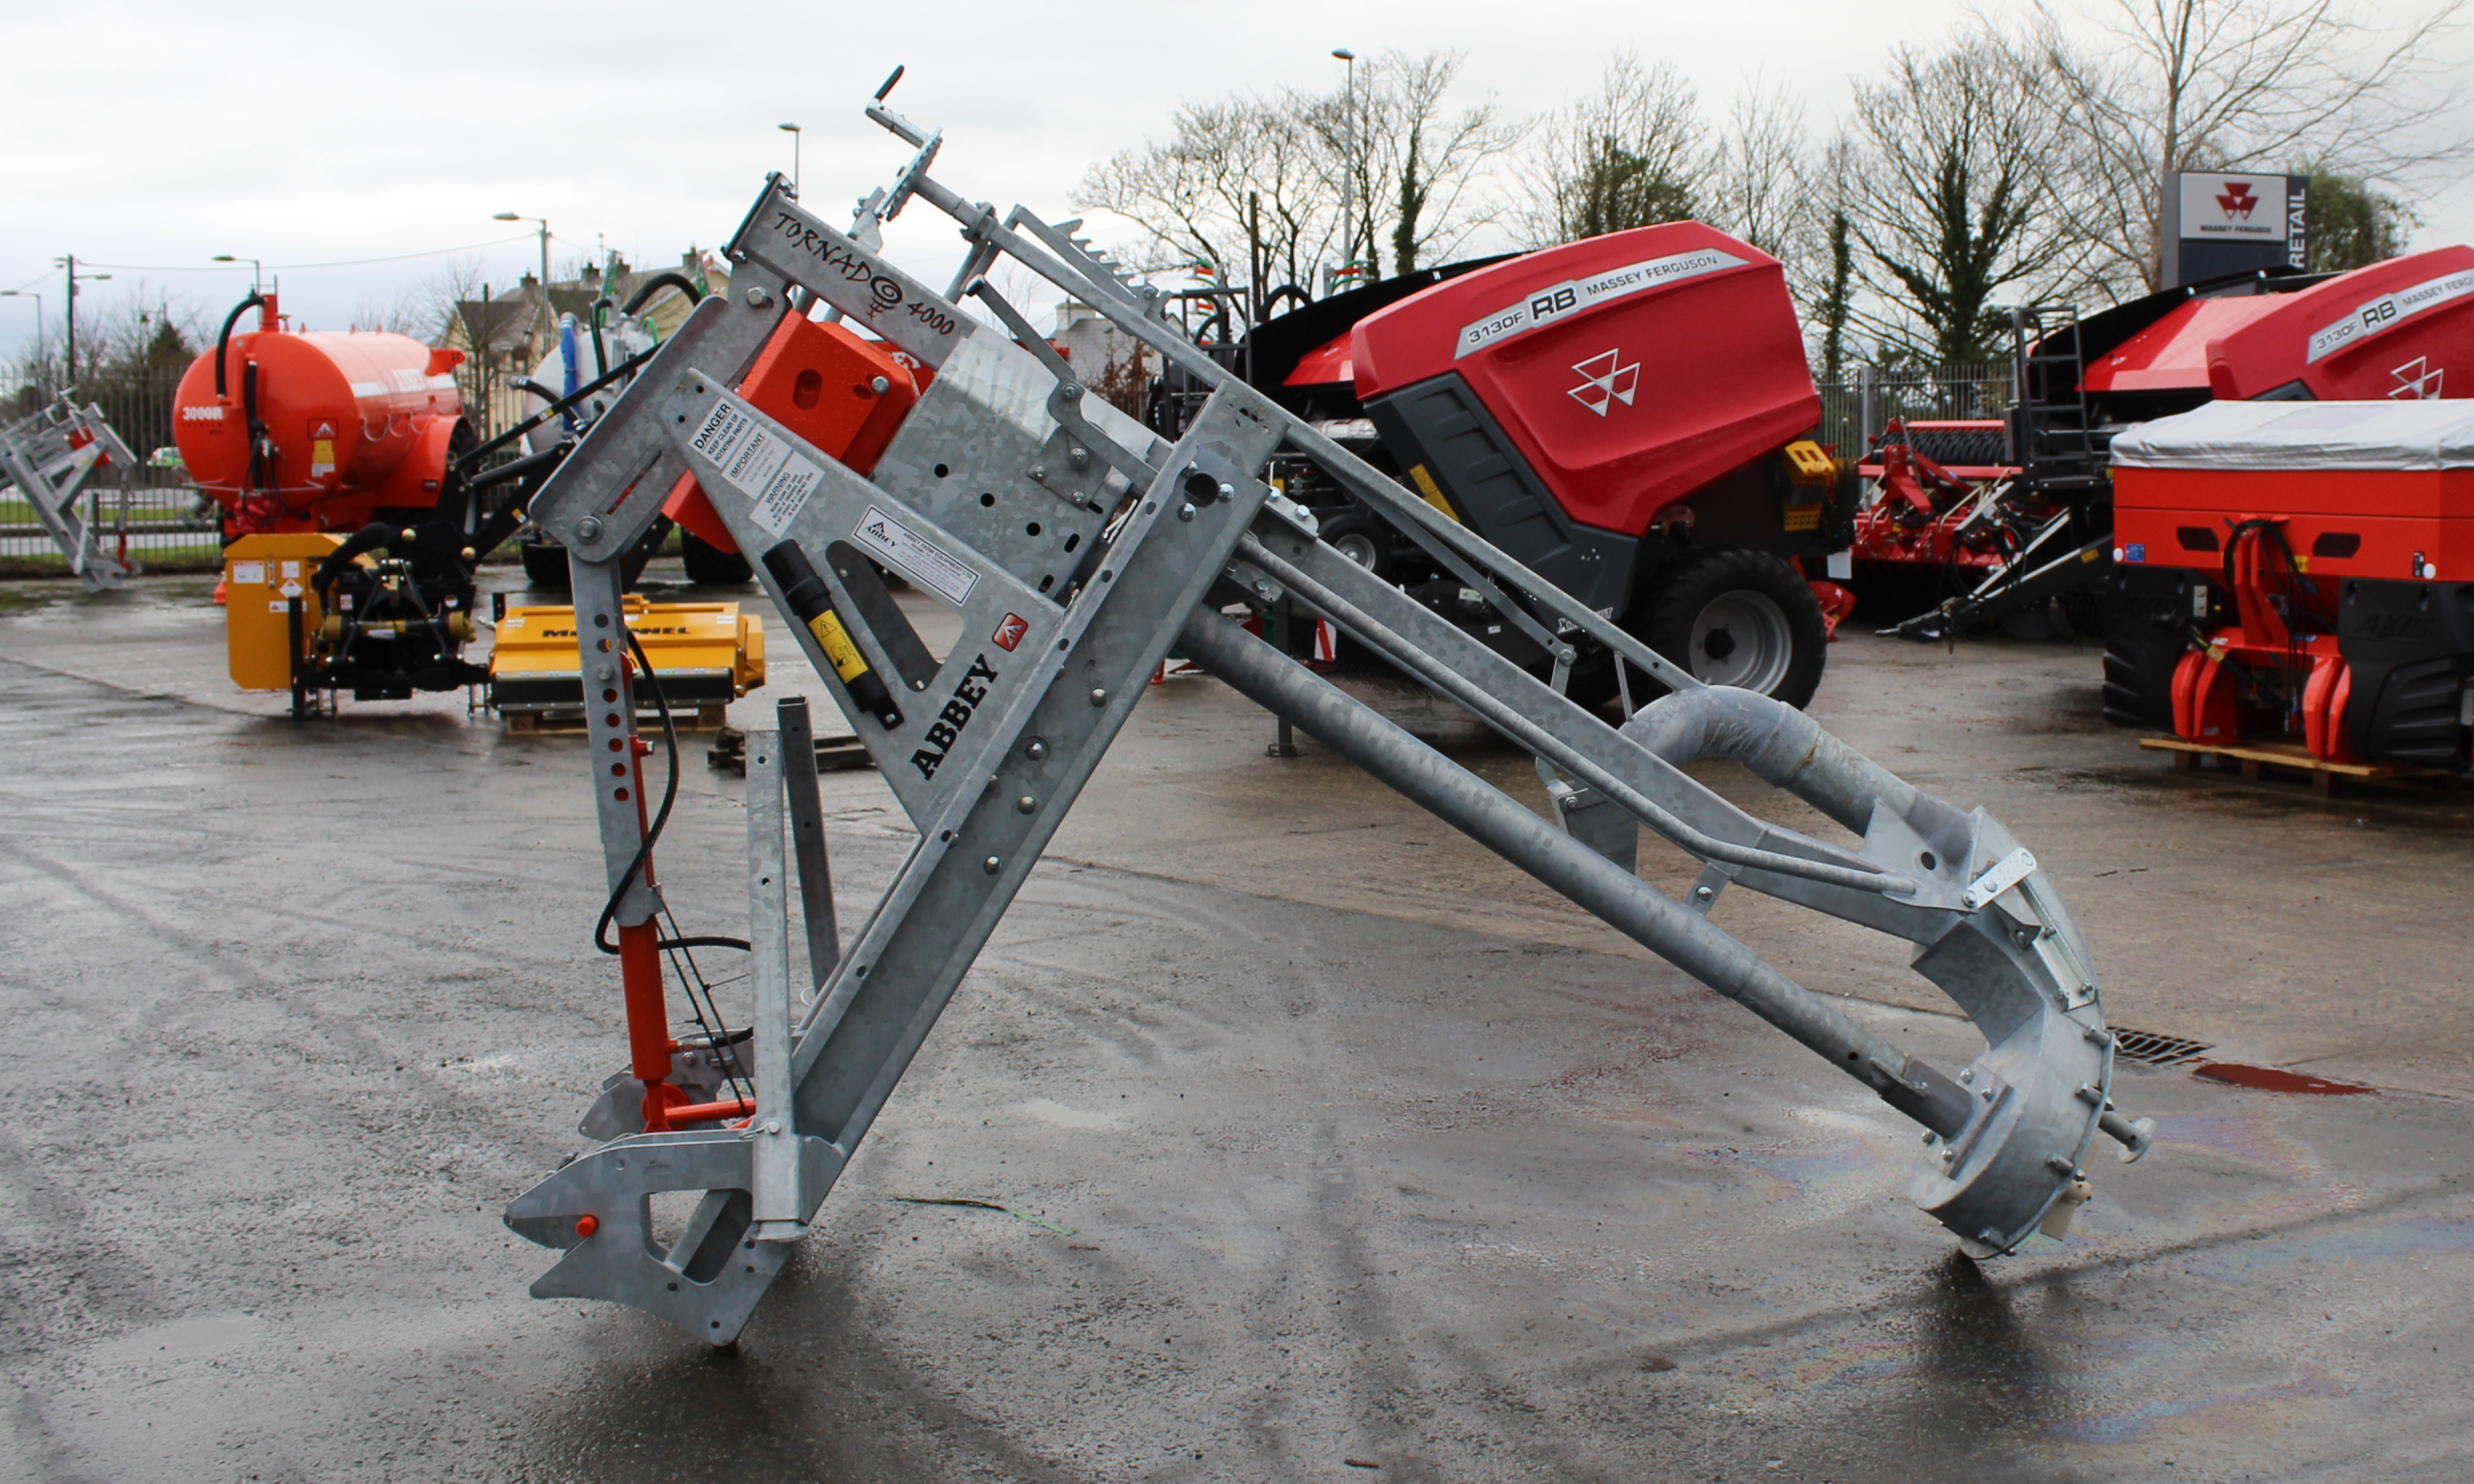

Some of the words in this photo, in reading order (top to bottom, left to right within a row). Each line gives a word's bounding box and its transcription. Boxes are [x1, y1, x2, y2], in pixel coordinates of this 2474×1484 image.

[2234, 225, 2271, 234] FERGUSON
[2288, 188, 2306, 269] RETAIL
[907, 301, 955, 335] 4000
[1468, 311, 1524, 344] 3130F
[1531, 288, 1577, 320] RB
[1586, 271, 1642, 296] MASSEY
[1646, 255, 1718, 279] FERGUSON
[2316, 322, 2358, 349] 3130F
[2362, 300, 2397, 328] RB
[2402, 285, 2444, 306] MASSEY
[182, 406, 223, 420] 3000R
[693, 402, 731, 449] DANGER
[706, 439, 720, 455] KEEP
[717, 420, 734, 441] CLEAR
[730, 413, 739, 422] OF
[712, 434, 735, 462] ROTATING
[732, 416, 748, 436] PARTS
[729, 431, 765, 478] IMPORTANT
[763, 471, 791, 504] WARNING
[903, 531, 921, 545] ABBEY
[920, 542, 935, 554] FARM
[934, 552, 963, 572] EQUIPMENT
[910, 653, 998, 781] ABBEY
